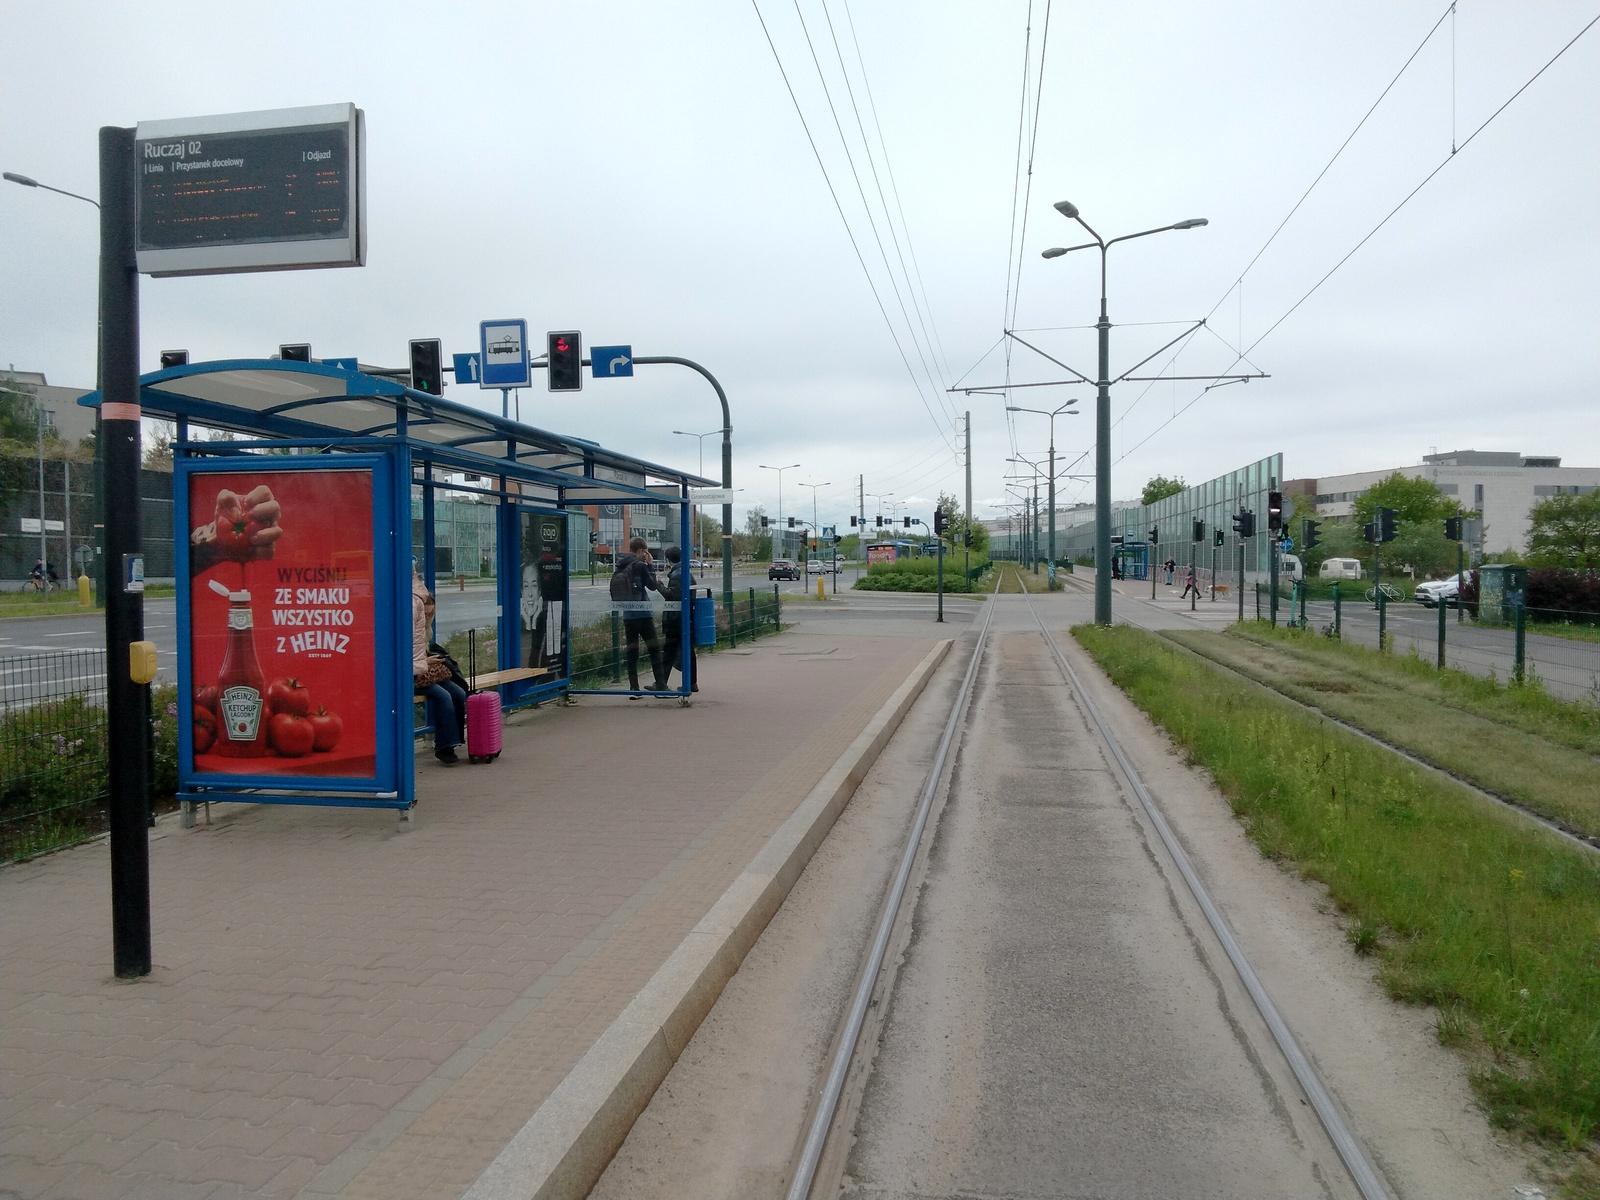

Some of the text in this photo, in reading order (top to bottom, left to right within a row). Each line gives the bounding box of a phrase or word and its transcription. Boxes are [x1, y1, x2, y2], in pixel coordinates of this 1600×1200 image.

[144, 140, 202, 159] Ruczaj 02
[307, 149, 332, 162] Odjazd
[148, 158, 244, 174] Linia Przystanek docelowy
[275, 588, 350, 605] ZE SMAKU
[272, 609, 354, 626] WSZYSTKO
[277, 630, 350, 654] Z HEINZ
[231, 692, 253, 701] HEINZ
[228, 704, 257, 712] KETCHUP
